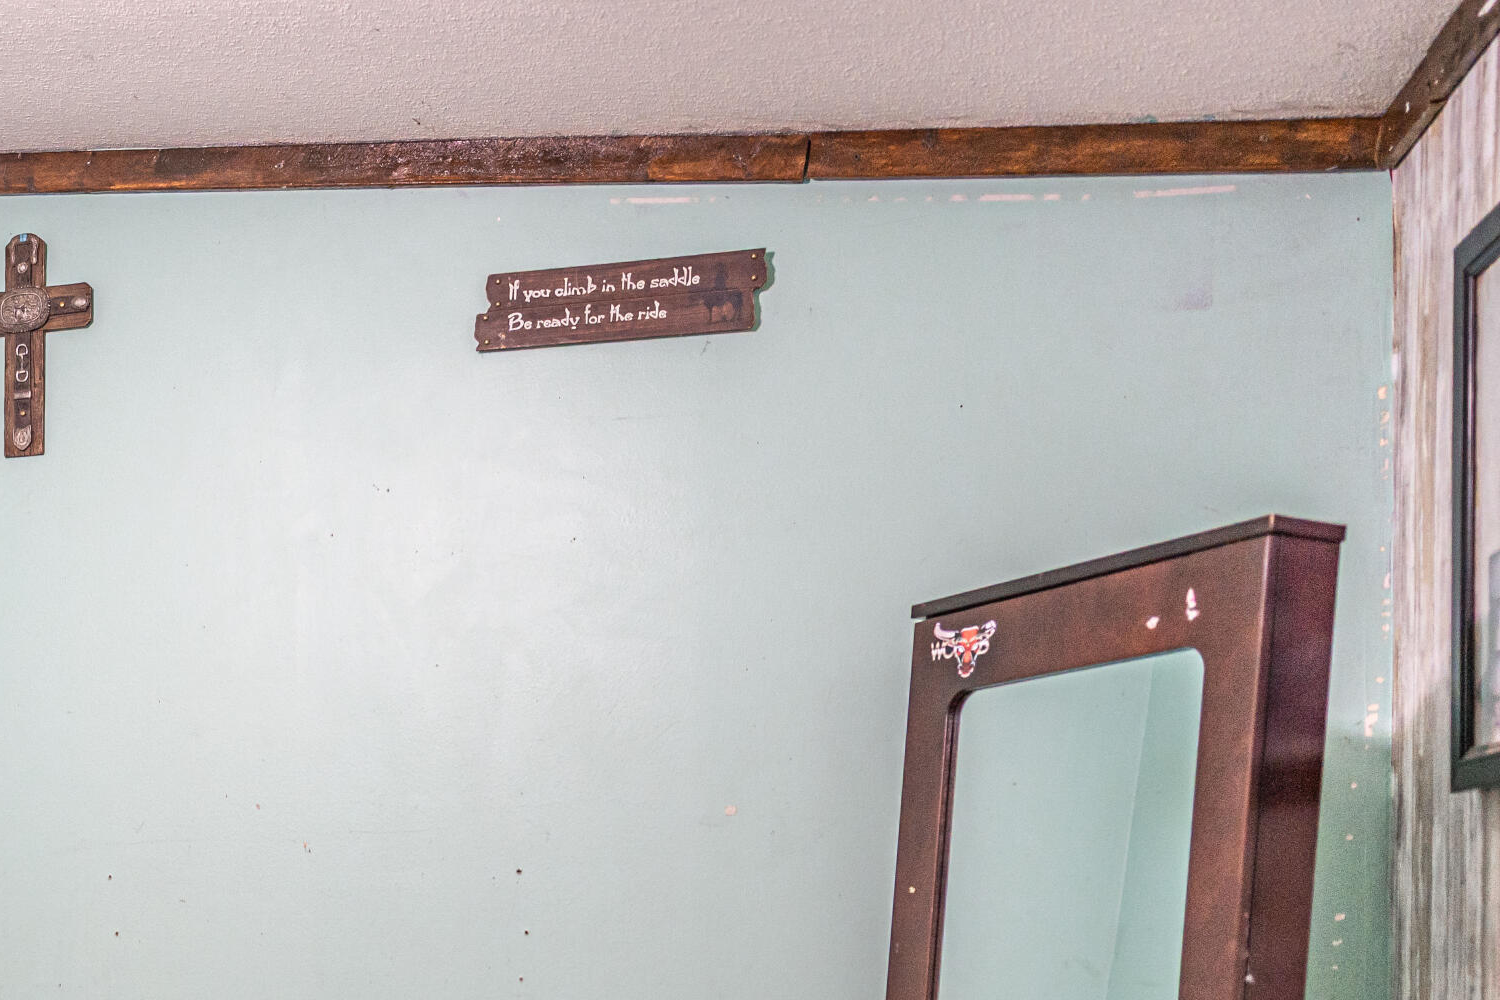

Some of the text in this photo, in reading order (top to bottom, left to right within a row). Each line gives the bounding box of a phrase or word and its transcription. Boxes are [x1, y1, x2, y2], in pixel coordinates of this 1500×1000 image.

[508, 266, 701, 302] If you climb in the saddle
[508, 300, 667, 332] Be ready for the ride
